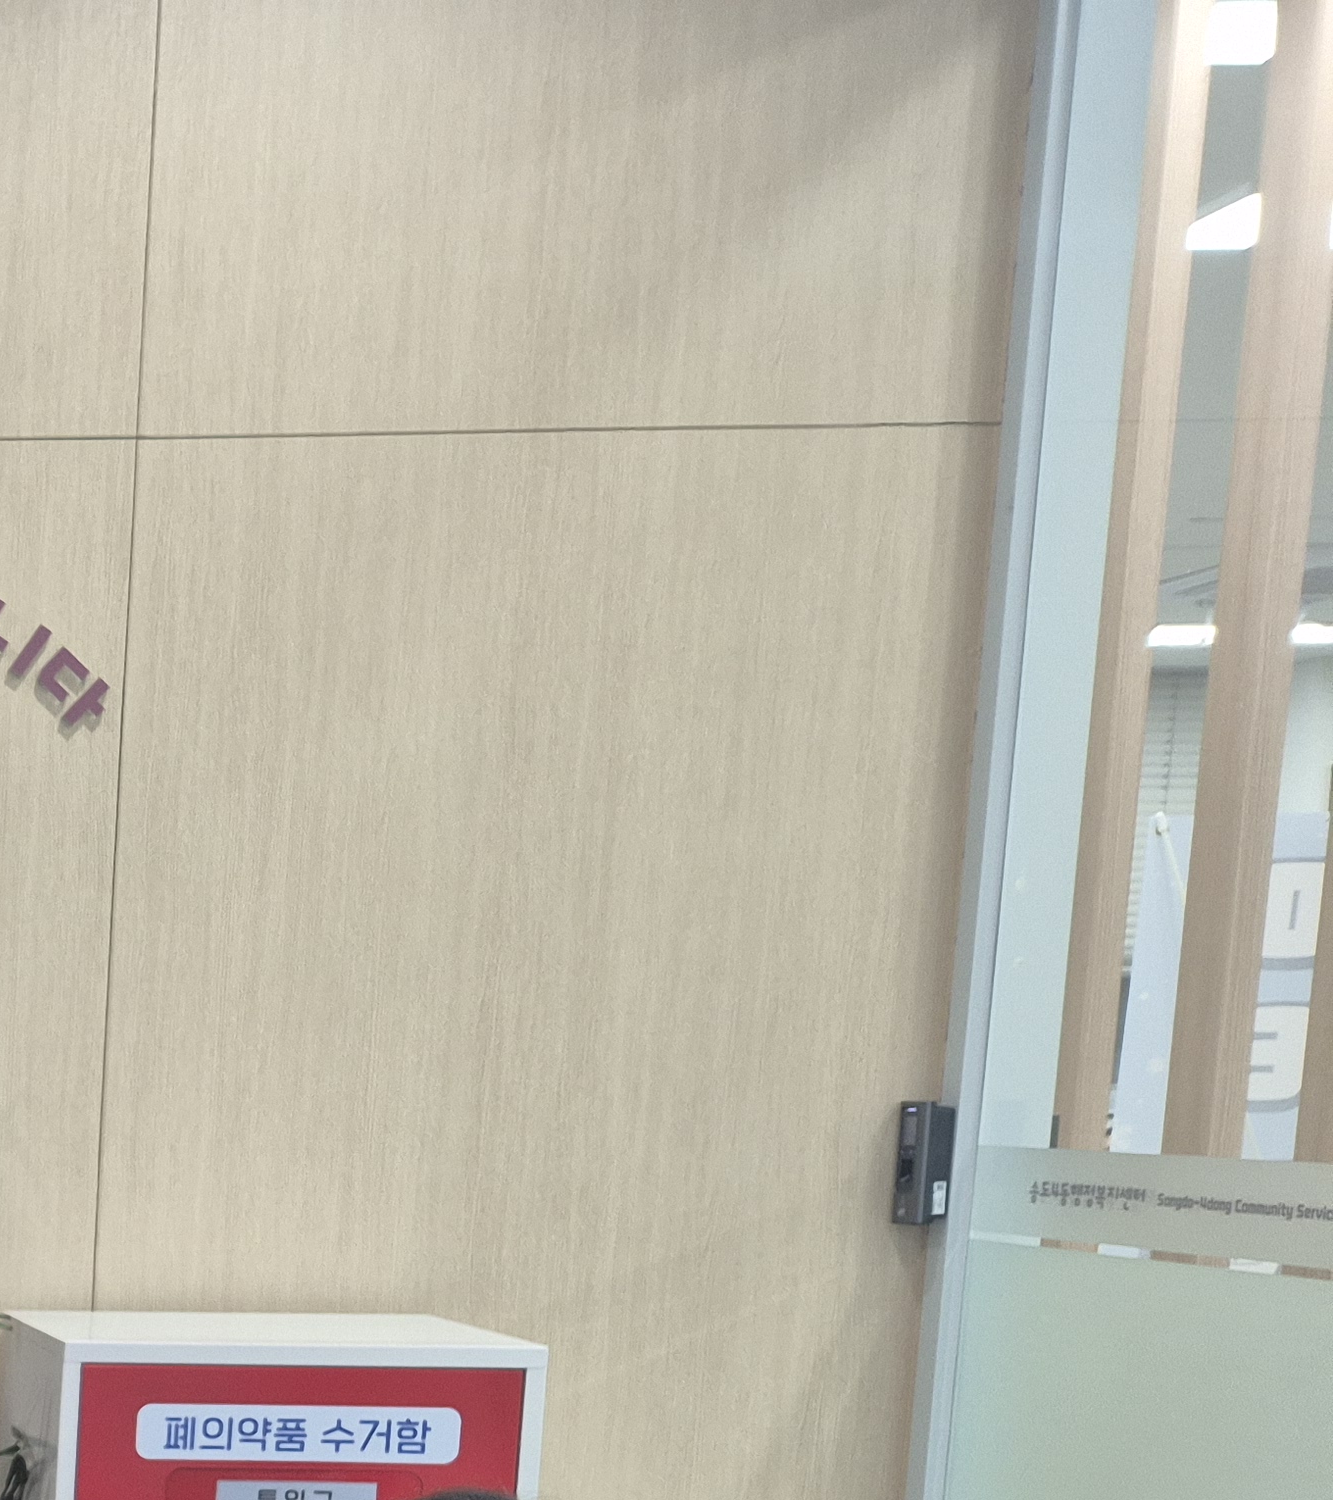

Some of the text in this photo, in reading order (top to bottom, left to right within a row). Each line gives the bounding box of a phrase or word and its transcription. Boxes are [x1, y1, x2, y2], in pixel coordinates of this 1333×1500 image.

[1235, 1199, 1293, 1220] Community
[163, 1415, 432, 1455] 폐의약품 수거함
